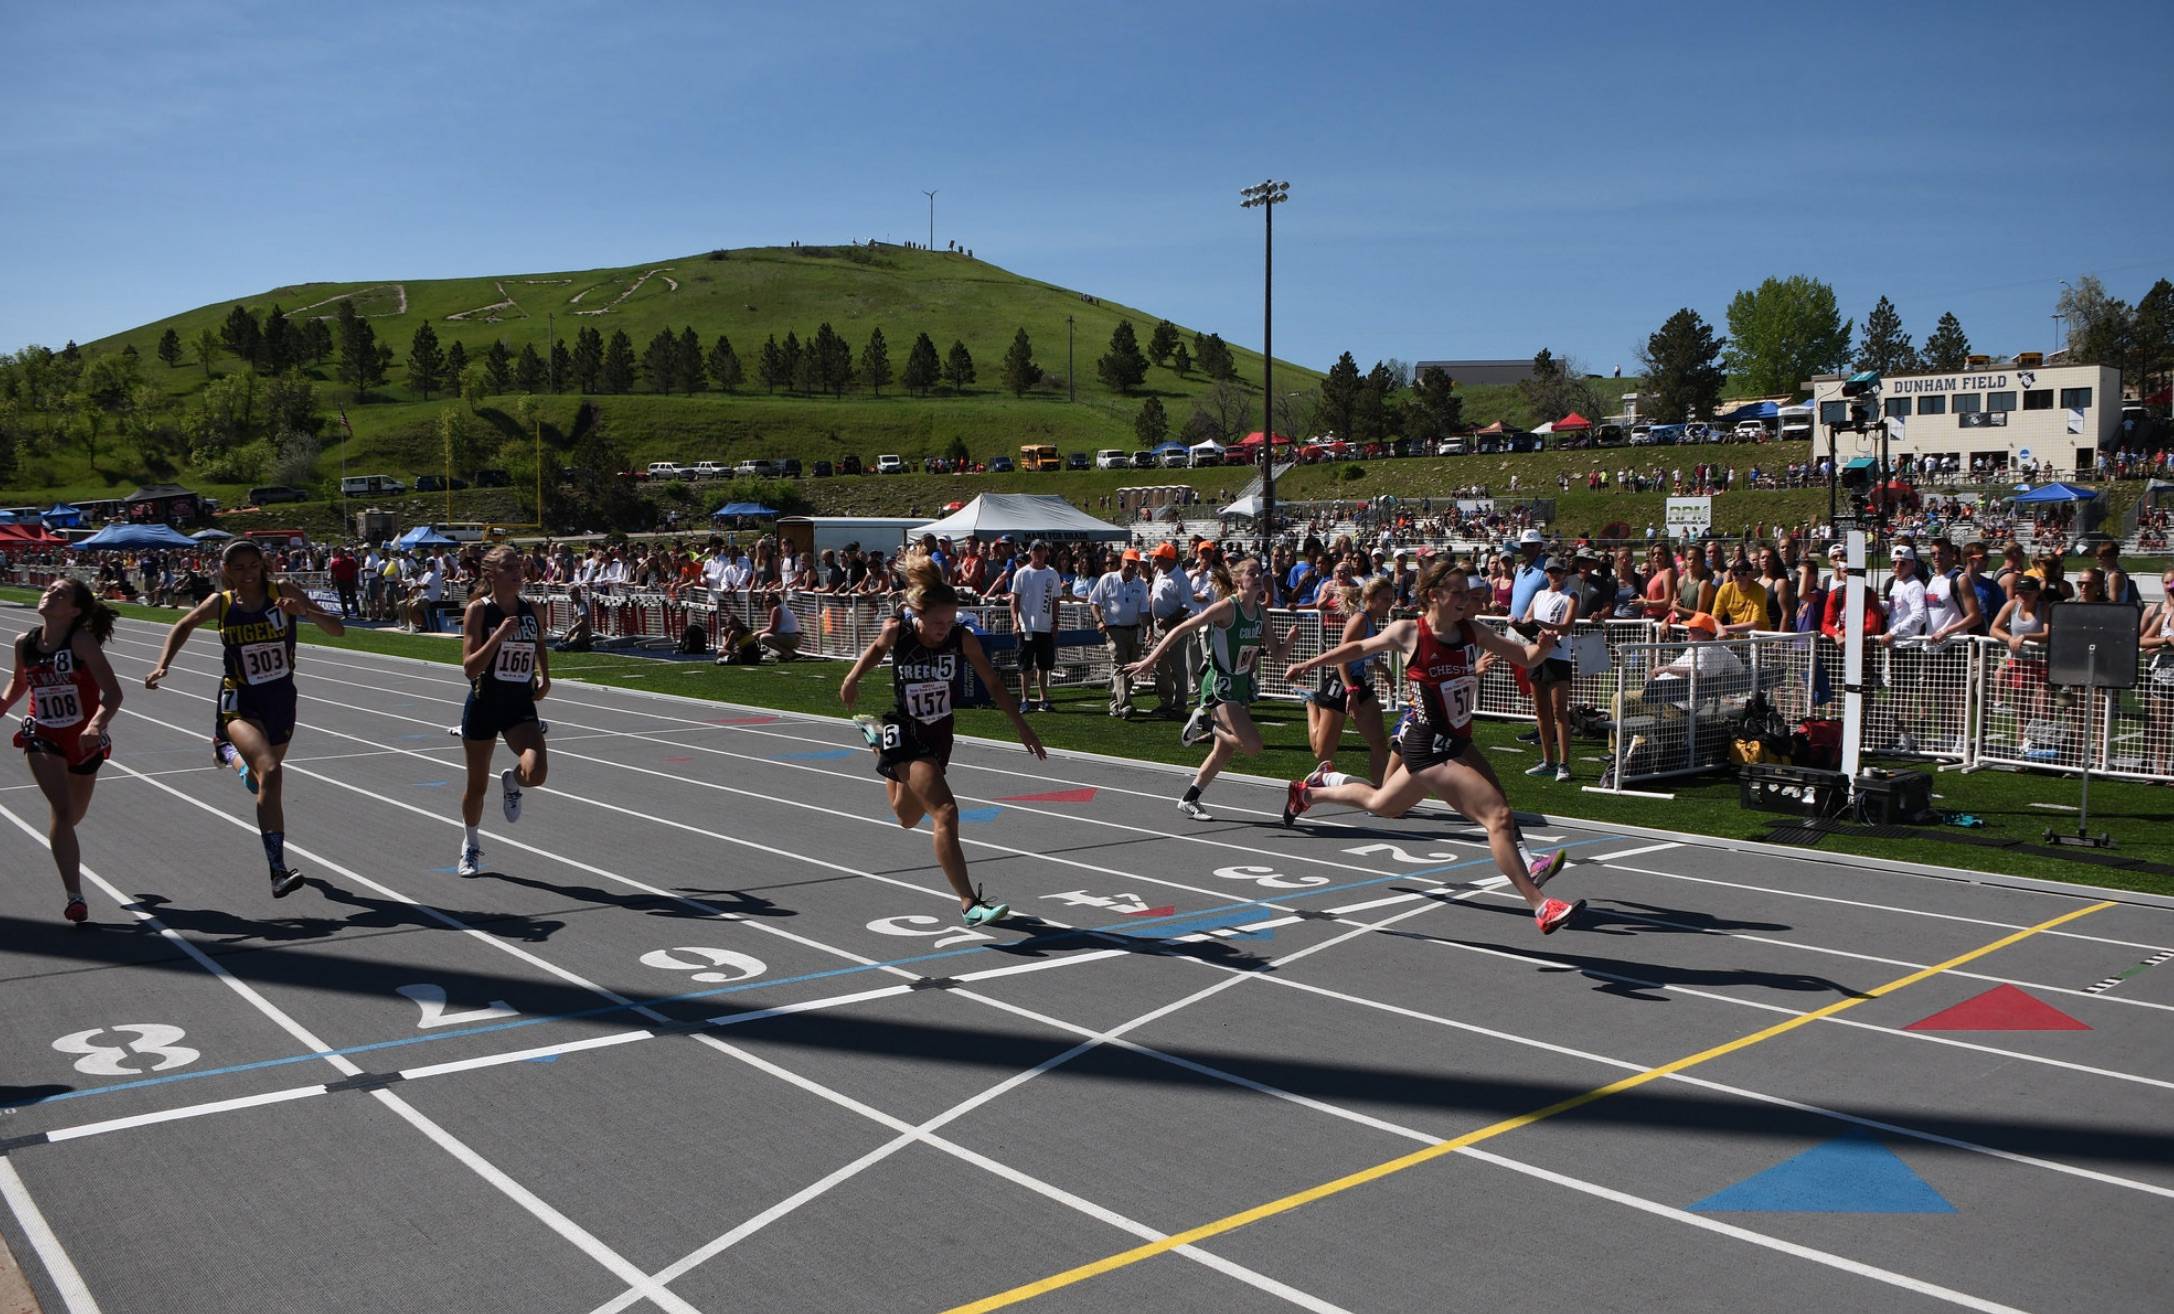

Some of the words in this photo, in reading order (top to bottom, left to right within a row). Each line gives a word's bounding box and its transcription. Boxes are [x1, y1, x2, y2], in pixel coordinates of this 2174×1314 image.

[1894, 377, 1956, 393] DUNHAM
[1963, 375, 2007, 390] FIELD
[267, 608, 282, 628] 7
[526, 616, 536, 635] 6
[56, 652, 70, 673] 8
[247, 647, 283, 675] 303
[499, 651, 529, 673] 166
[940, 656, 952, 678] 5
[1219, 678, 1229, 693] 2
[39, 694, 77, 720] 108
[223, 690, 235, 710] 7
[911, 690, 946, 717] 157
[1453, 686, 1470, 715] 57
[885, 725, 896, 747] 5
[1342, 843, 1458, 864] 2
[1212, 865, 1330, 888] 3
[1038, 889, 1150, 914] 4
[866, 915, 997, 948] 5
[395, 983, 521, 1029] 7
[51, 1023, 200, 1076] 8
